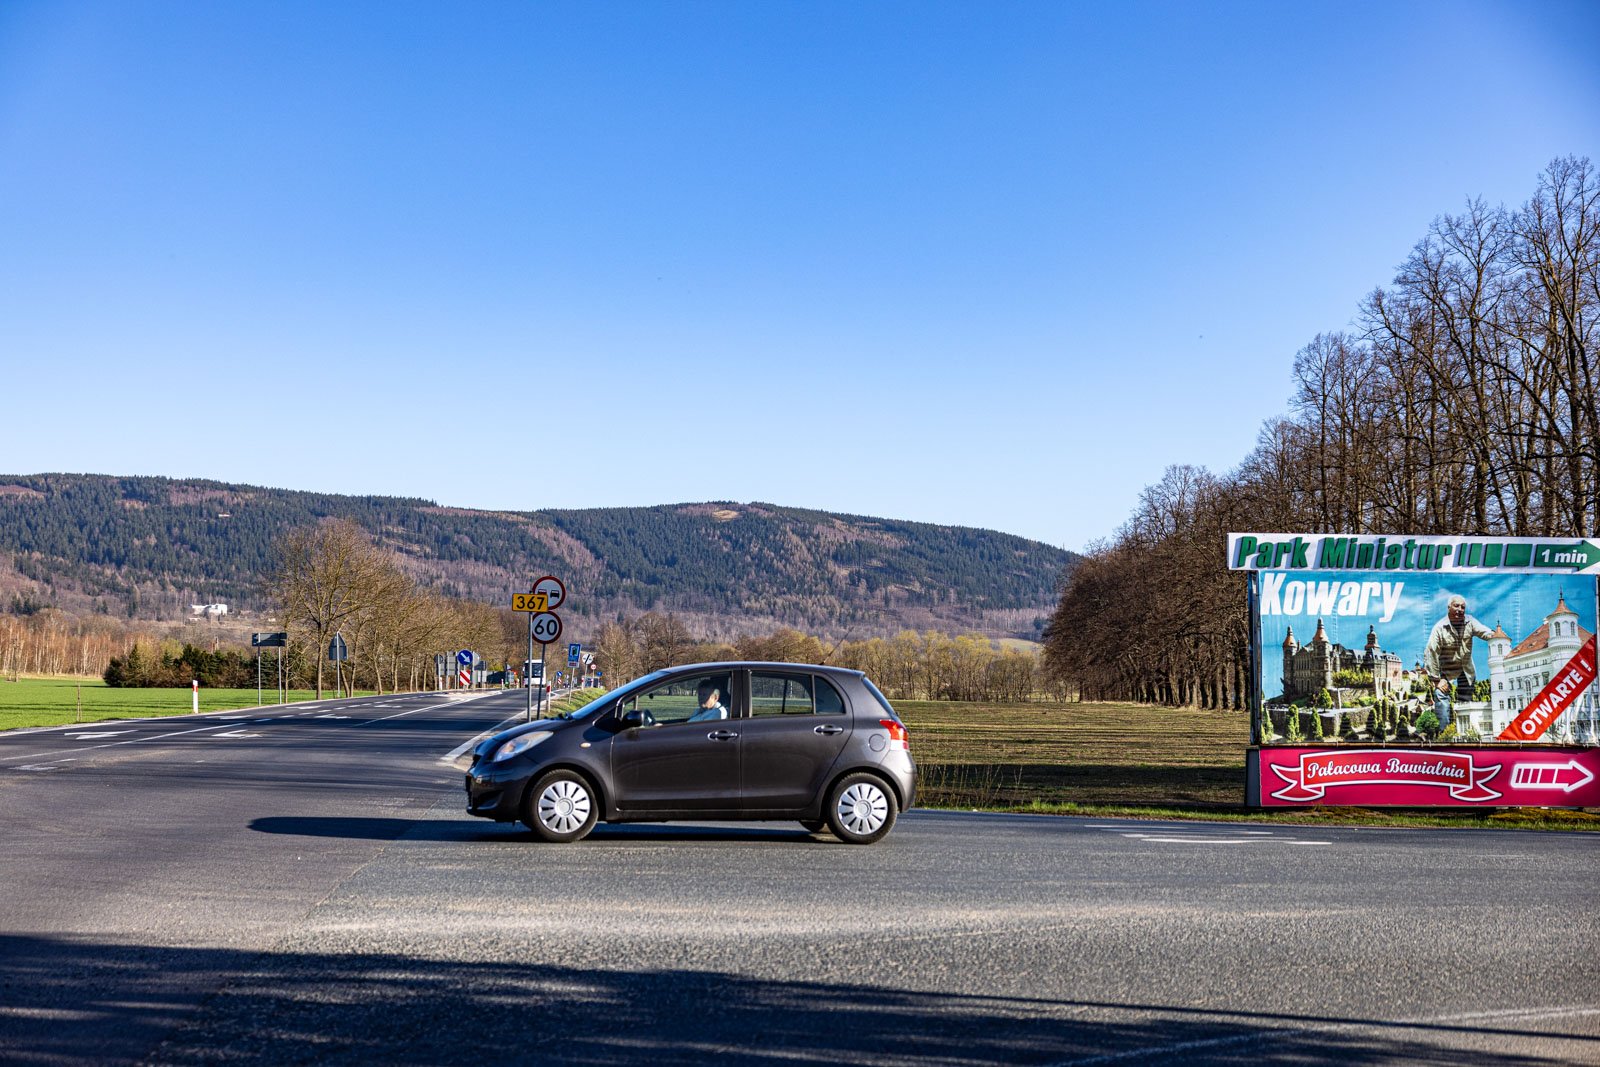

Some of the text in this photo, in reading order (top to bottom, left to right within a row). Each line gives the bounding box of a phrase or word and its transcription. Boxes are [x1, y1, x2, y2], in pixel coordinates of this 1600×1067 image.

[1235, 536, 1454, 570] Park Miniatur
[1541, 549, 1588, 564] 1 min
[517, 596, 544, 609] 367
[1260, 572, 1404, 622] Kowary
[534, 620, 557, 635] 60
[1520, 669, 1584, 736] OTWARTE
[1306, 758, 1465, 779] Pałacowa Bawialnia
